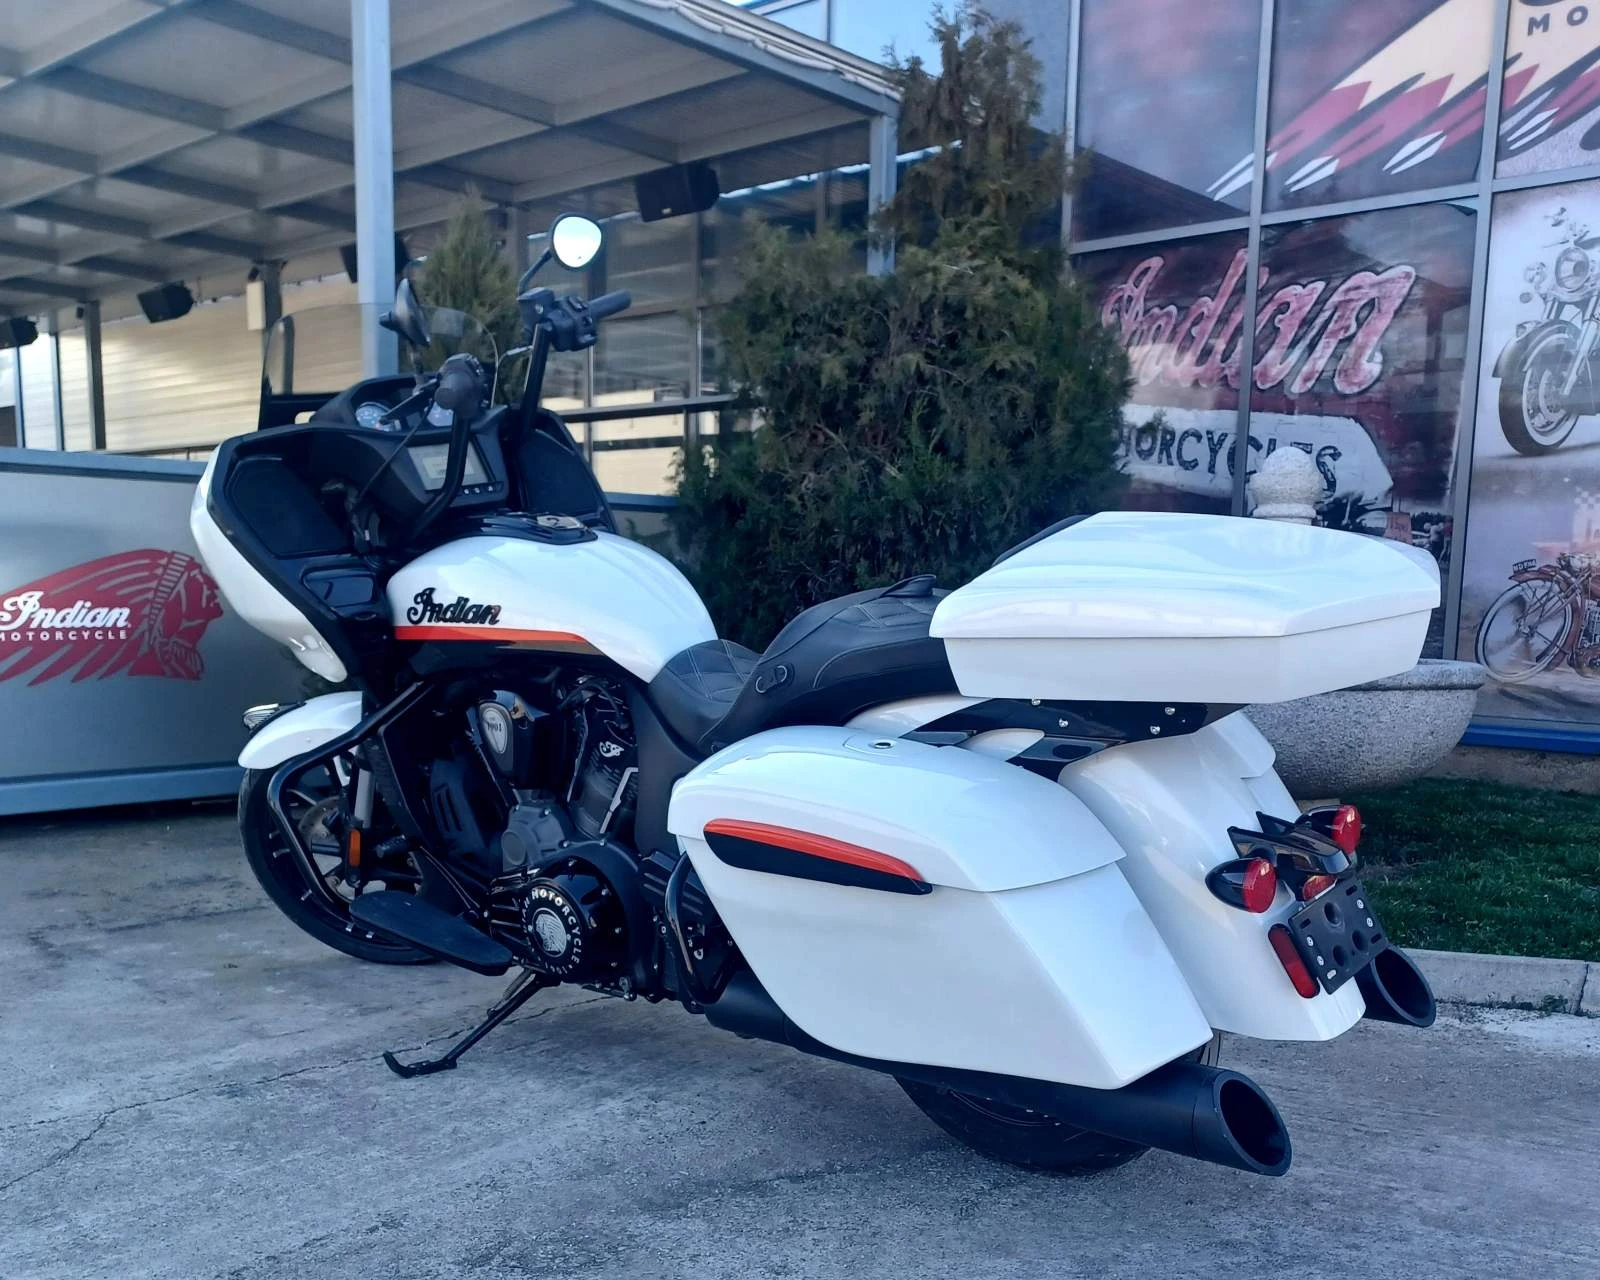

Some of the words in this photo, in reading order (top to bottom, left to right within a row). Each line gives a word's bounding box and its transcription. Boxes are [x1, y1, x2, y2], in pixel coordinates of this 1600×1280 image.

[1101, 248, 1416, 395] Indian
[0, 590, 131, 630] Indian
[406, 587, 502, 625] Indian
[532, 888, 582, 964] MOTORCYCLE
